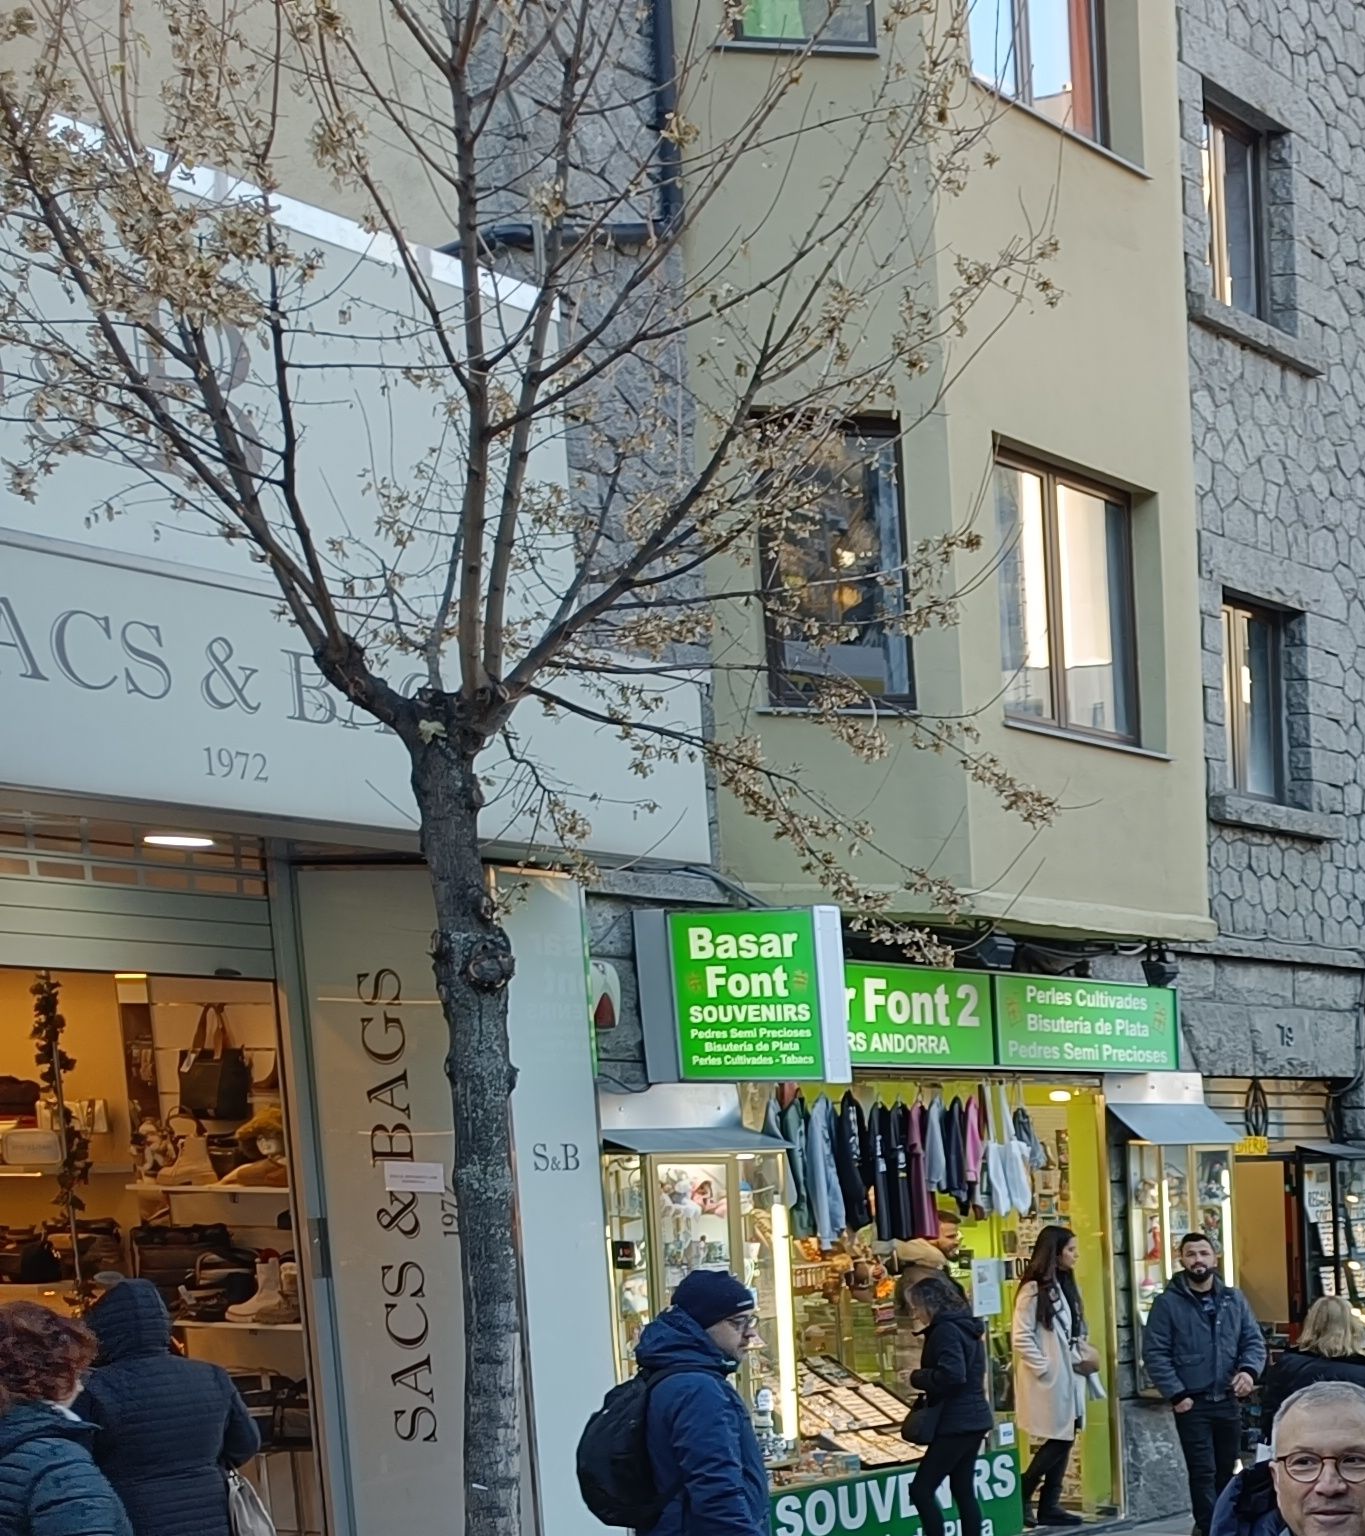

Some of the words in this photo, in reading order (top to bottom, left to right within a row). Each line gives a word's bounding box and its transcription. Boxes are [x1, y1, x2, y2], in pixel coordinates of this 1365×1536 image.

[200, 637, 261, 714] &
[203, 746, 269, 783] 1972
[688, 927, 798, 960] Basar
[705, 965, 789, 998] Font
[864, 977, 951, 1027] Font
[956, 983, 981, 1028] 2
[1026, 985, 1073, 1006] Perles
[1075, 988, 1148, 1011] Cultivades
[689, 1003, 812, 1024] SOUVENIRS
[1095, 1018, 1113, 1036] de
[1115, 1018, 1150, 1038] Plata
[690, 1029, 728, 1040] Pedres
[730, 1027, 757, 1039] Semi
[759, 1027, 812, 1039] Precioses
[755, 1041, 769, 1052] de
[771, 1040, 800, 1052] Plata
[870, 1032, 951, 1055] ANDORRA
[781, 1053, 815, 1065] Tabacs
[1008, 1040, 1060, 1060] Pedres
[1063, 1042, 1100, 1062] Semi
[1102, 1044, 1168, 1064] Precioses
[356, 968, 416, 1168] BAGS
[532, 1143, 580, 1172] S&B
[376, 1190, 421, 1239] &
[381, 1261, 439, 1443] SACS
